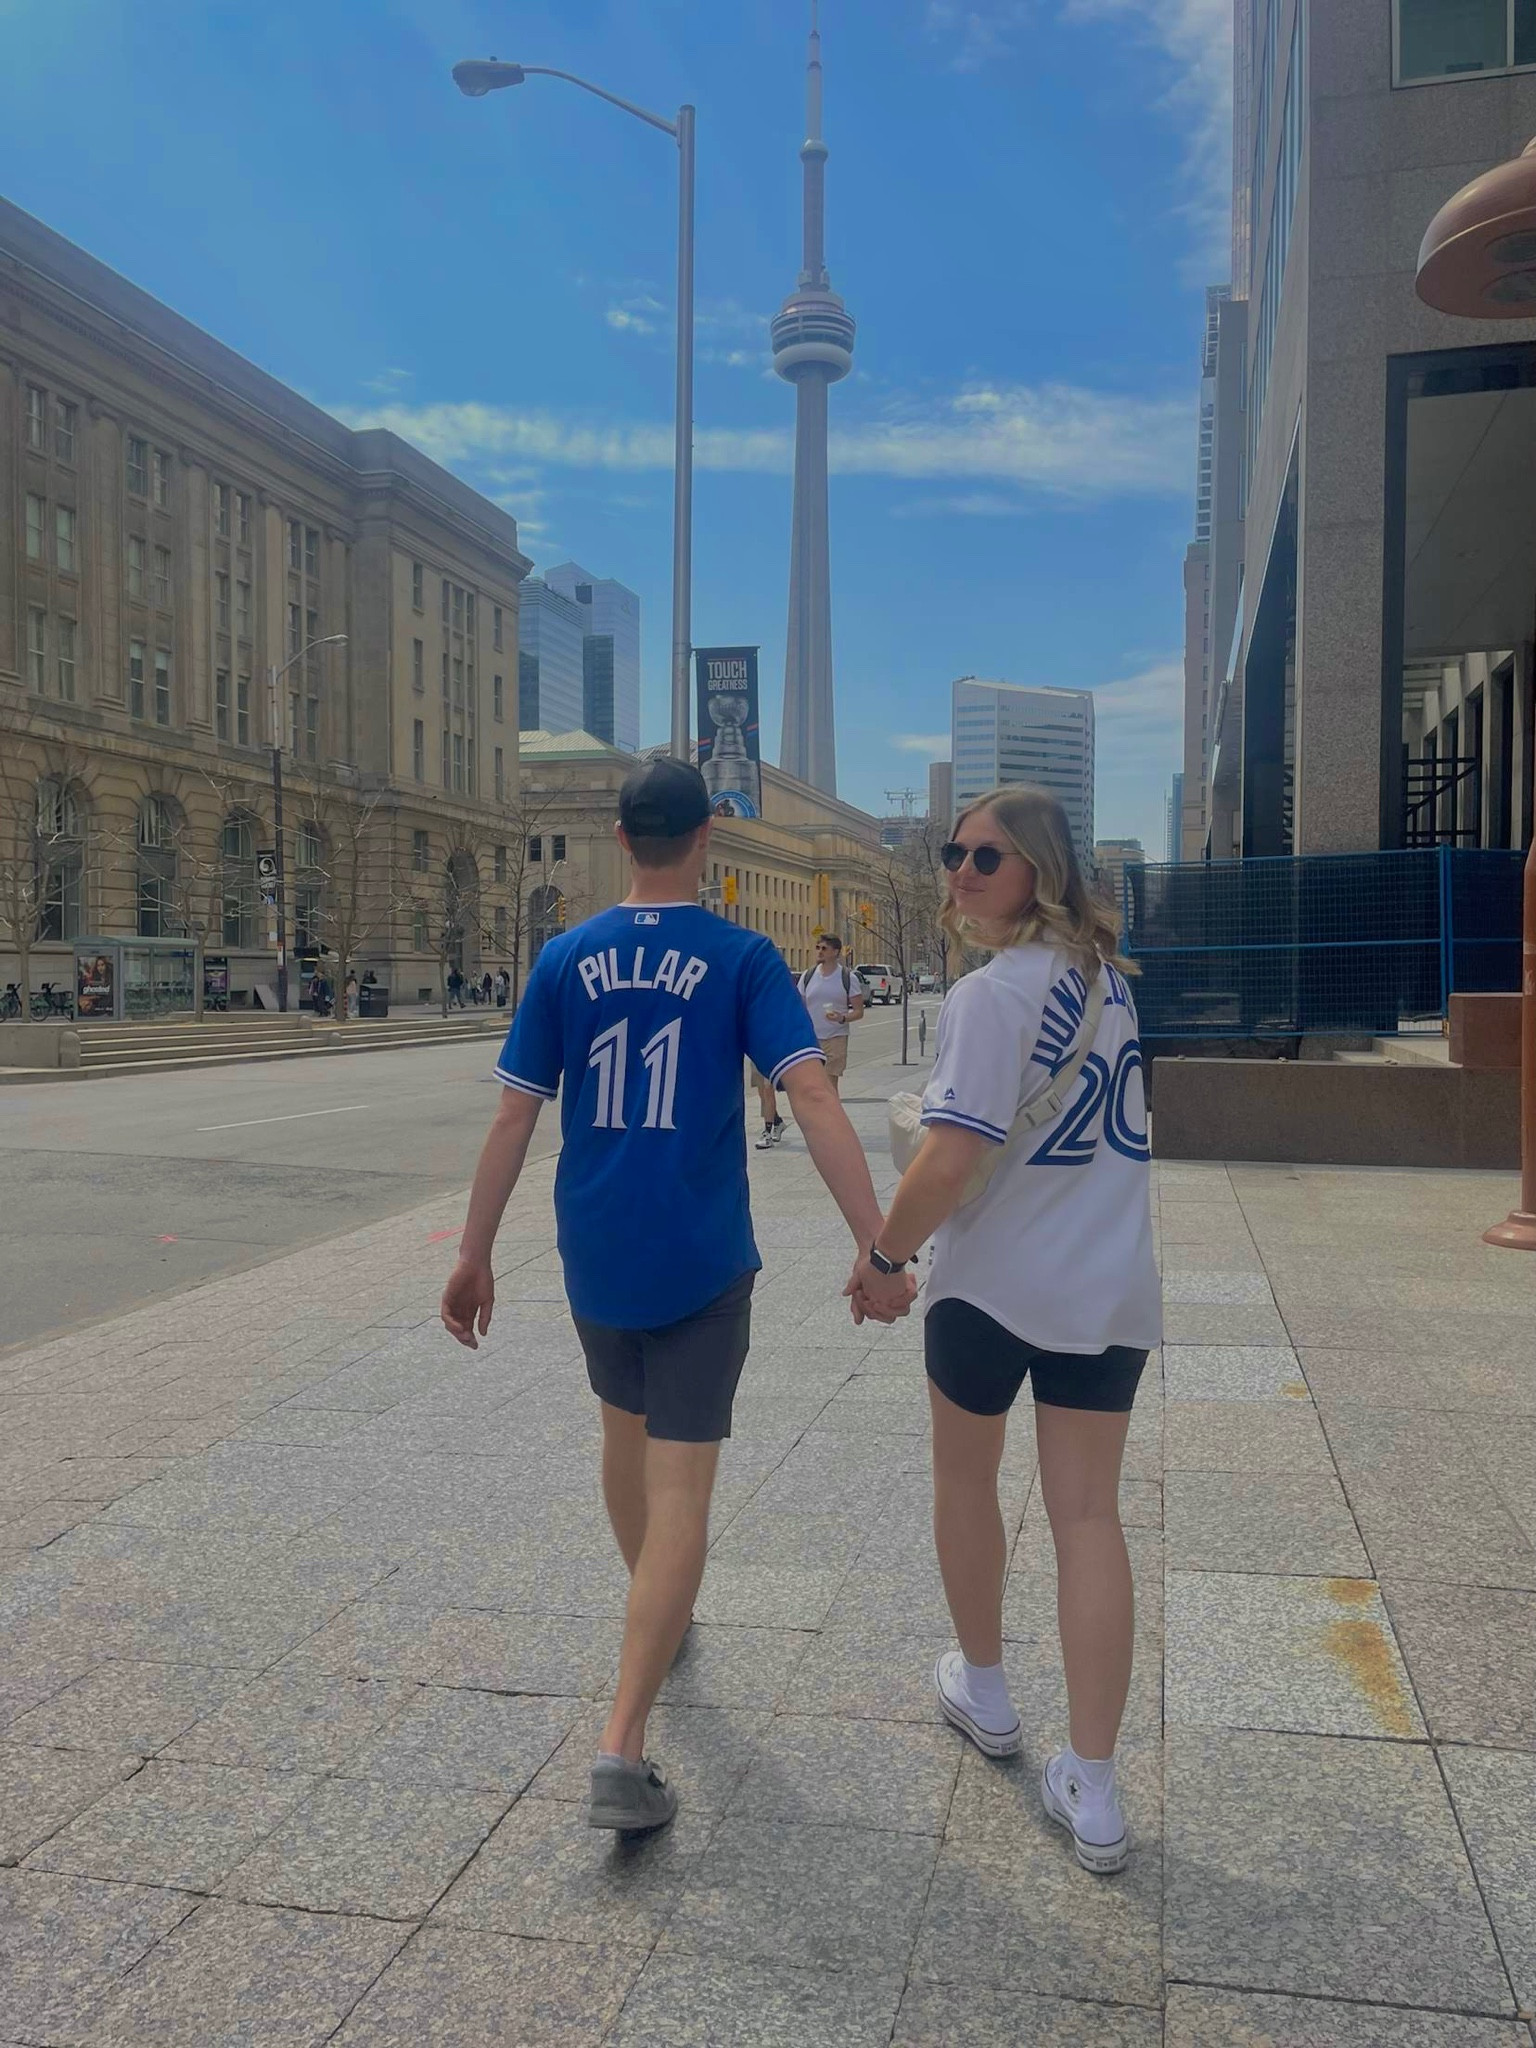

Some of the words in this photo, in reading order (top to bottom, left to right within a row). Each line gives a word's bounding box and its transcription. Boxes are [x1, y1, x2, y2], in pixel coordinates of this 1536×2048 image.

[707, 660, 747, 679] TOUCH
[708, 679, 747, 691] GREATNESS
[577, 946, 708, 1001] PILLAR
[588, 1017, 682, 1130] 11
[1025, 1039, 1152, 1166] 20
